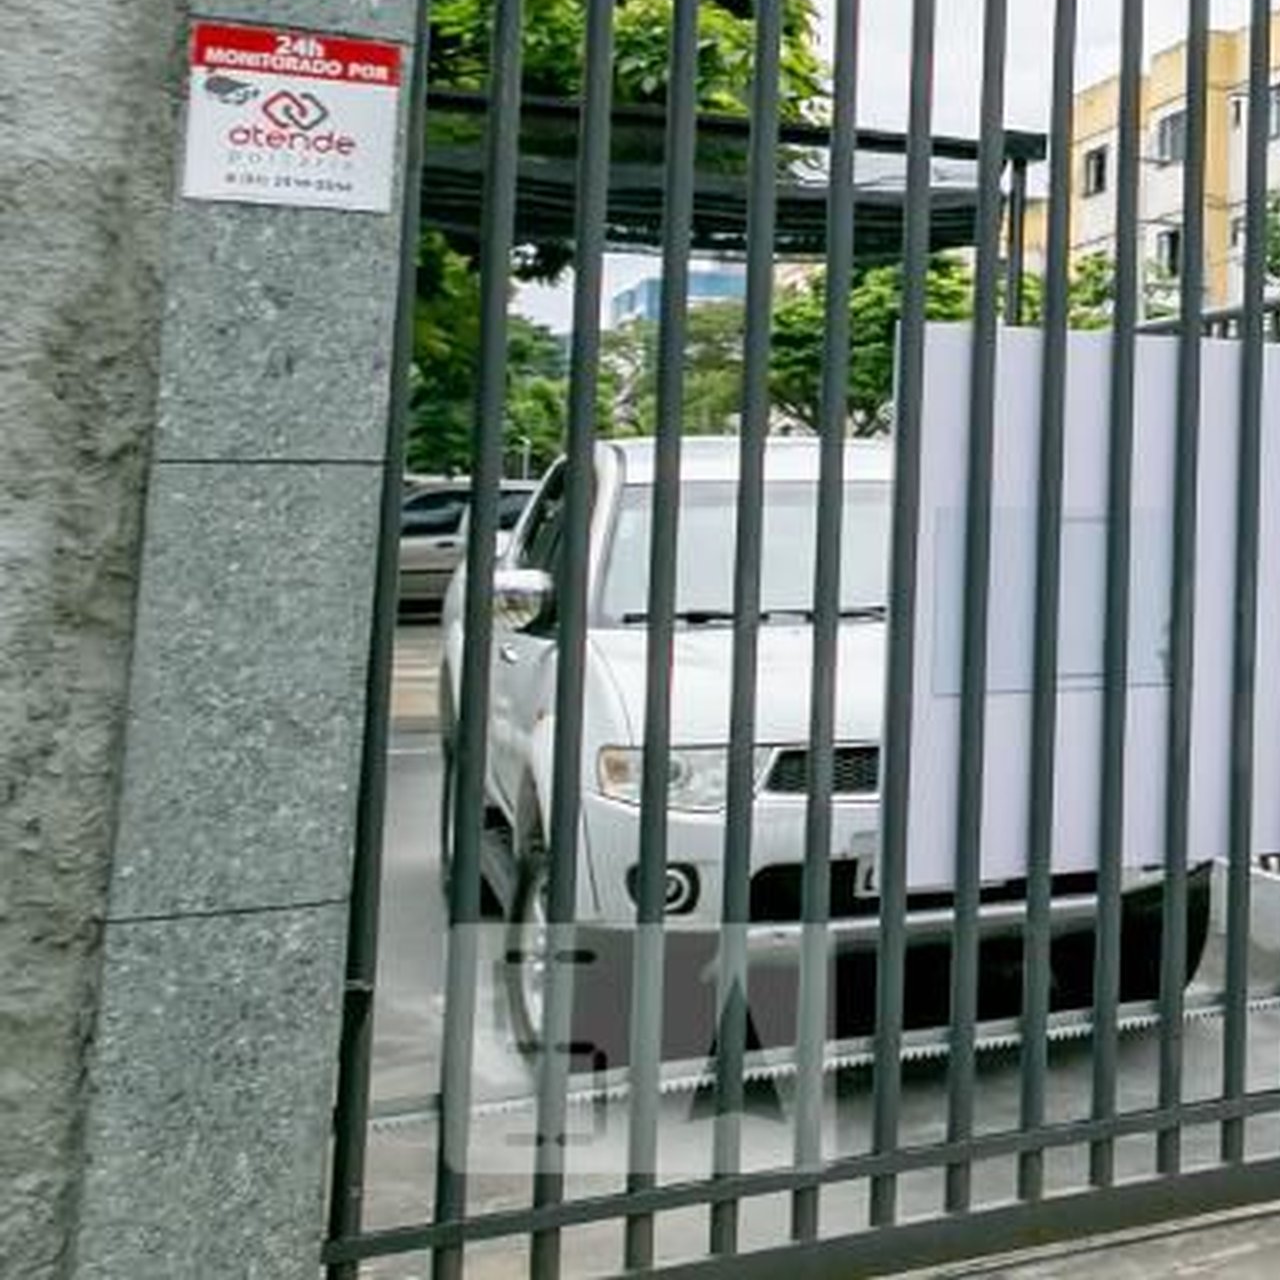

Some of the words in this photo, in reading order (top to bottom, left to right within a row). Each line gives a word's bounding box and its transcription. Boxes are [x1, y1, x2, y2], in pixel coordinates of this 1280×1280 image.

[274, 35, 326, 58] 24h
[204, 47, 343, 76] MONITORADO
[347, 62, 389, 80] POR
[228, 125, 356, 156] atende
